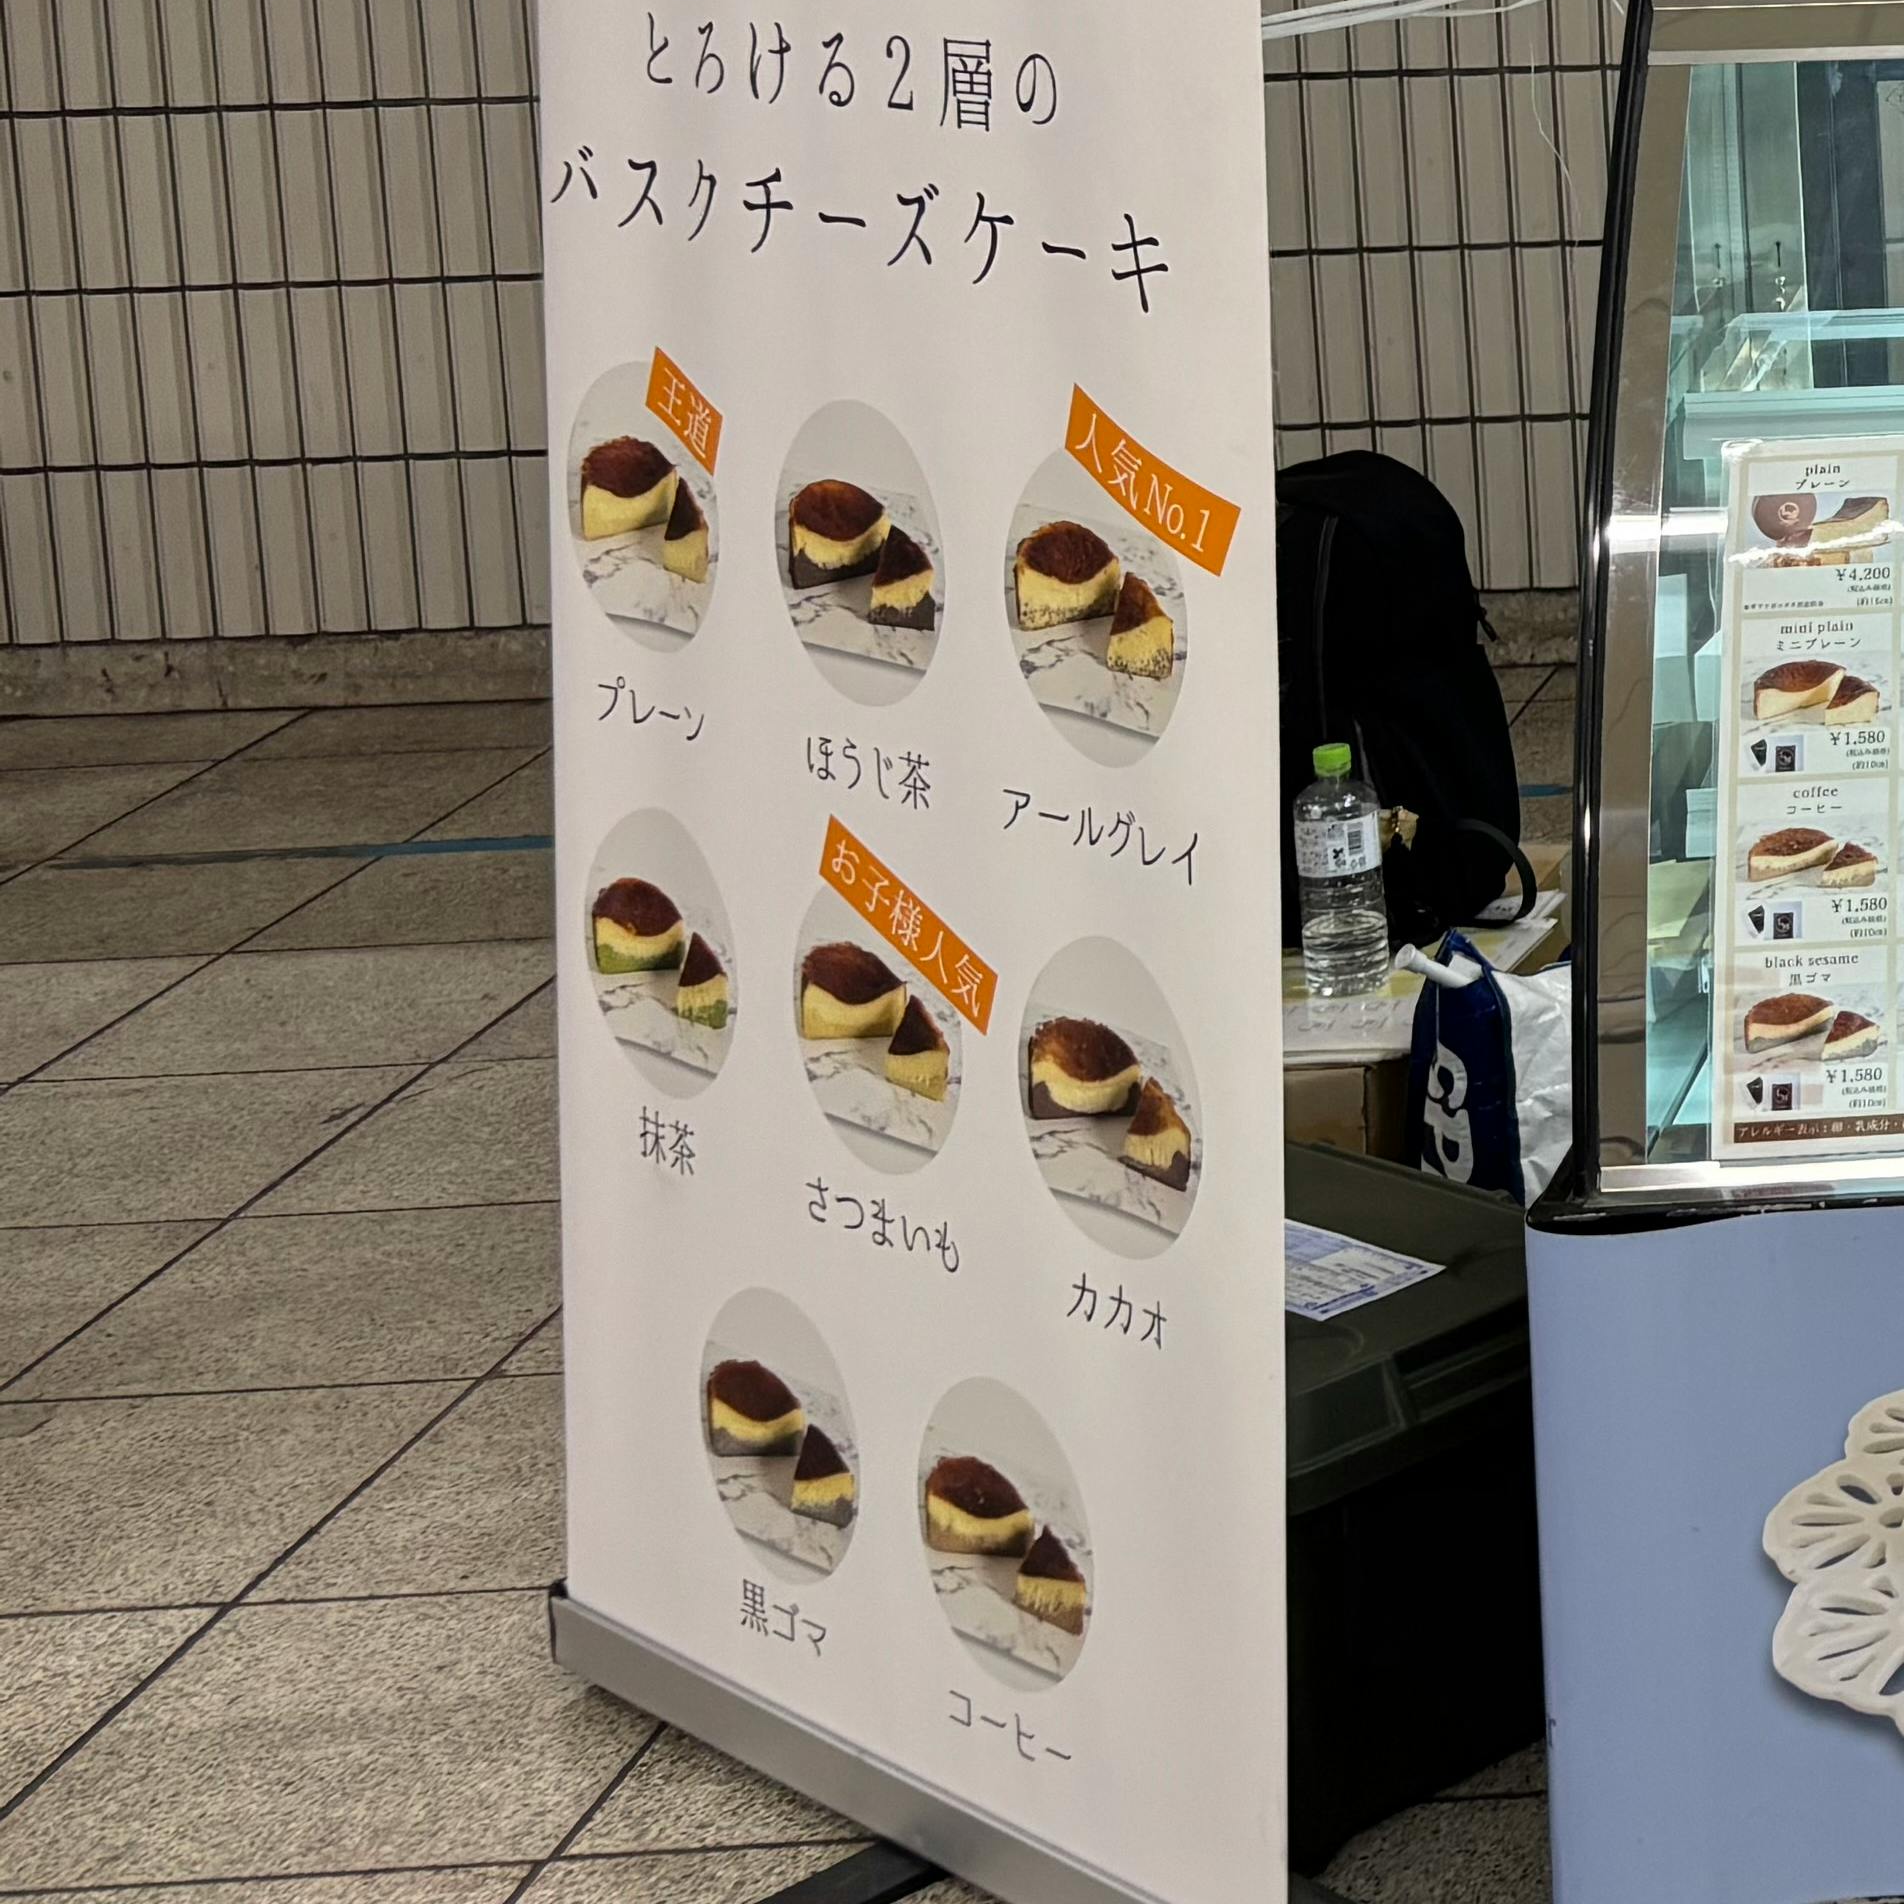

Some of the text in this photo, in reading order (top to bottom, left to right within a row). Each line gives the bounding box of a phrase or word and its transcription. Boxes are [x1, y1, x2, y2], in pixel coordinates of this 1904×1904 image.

[645, 11, 1059, 133] とろける2層の
[550, 144, 1170, 314] バスクチーズケーキ
[656, 366, 712, 460] 王道
[1073, 409, 1213, 554] 人気No.1
[1795, 479, 1850, 490] プレーン
[1805, 464, 1841, 477] plain
[1776, 638, 1861, 651] ミニプレーン
[1780, 620, 1854, 634] mini plain
[597, 676, 705, 742] プレーン
[806, 735, 932, 811] ほうじ茶
[1786, 803, 1843, 815] コーヒー
[1793, 786, 1839, 799] coffee
[1002, 788, 1198, 886] アールグレイ
[829, 841, 985, 1018] お子様人気
[1765, 955, 1859, 969] black sesame
[638, 1105, 697, 1177] 抹茶
[805, 1177, 961, 1274] さつまいも
[1068, 1272, 1169, 1350] カカオ
[739, 1578, 827, 1658] 黒ゴマ
[948, 1690, 1073, 1764] コーヒー
